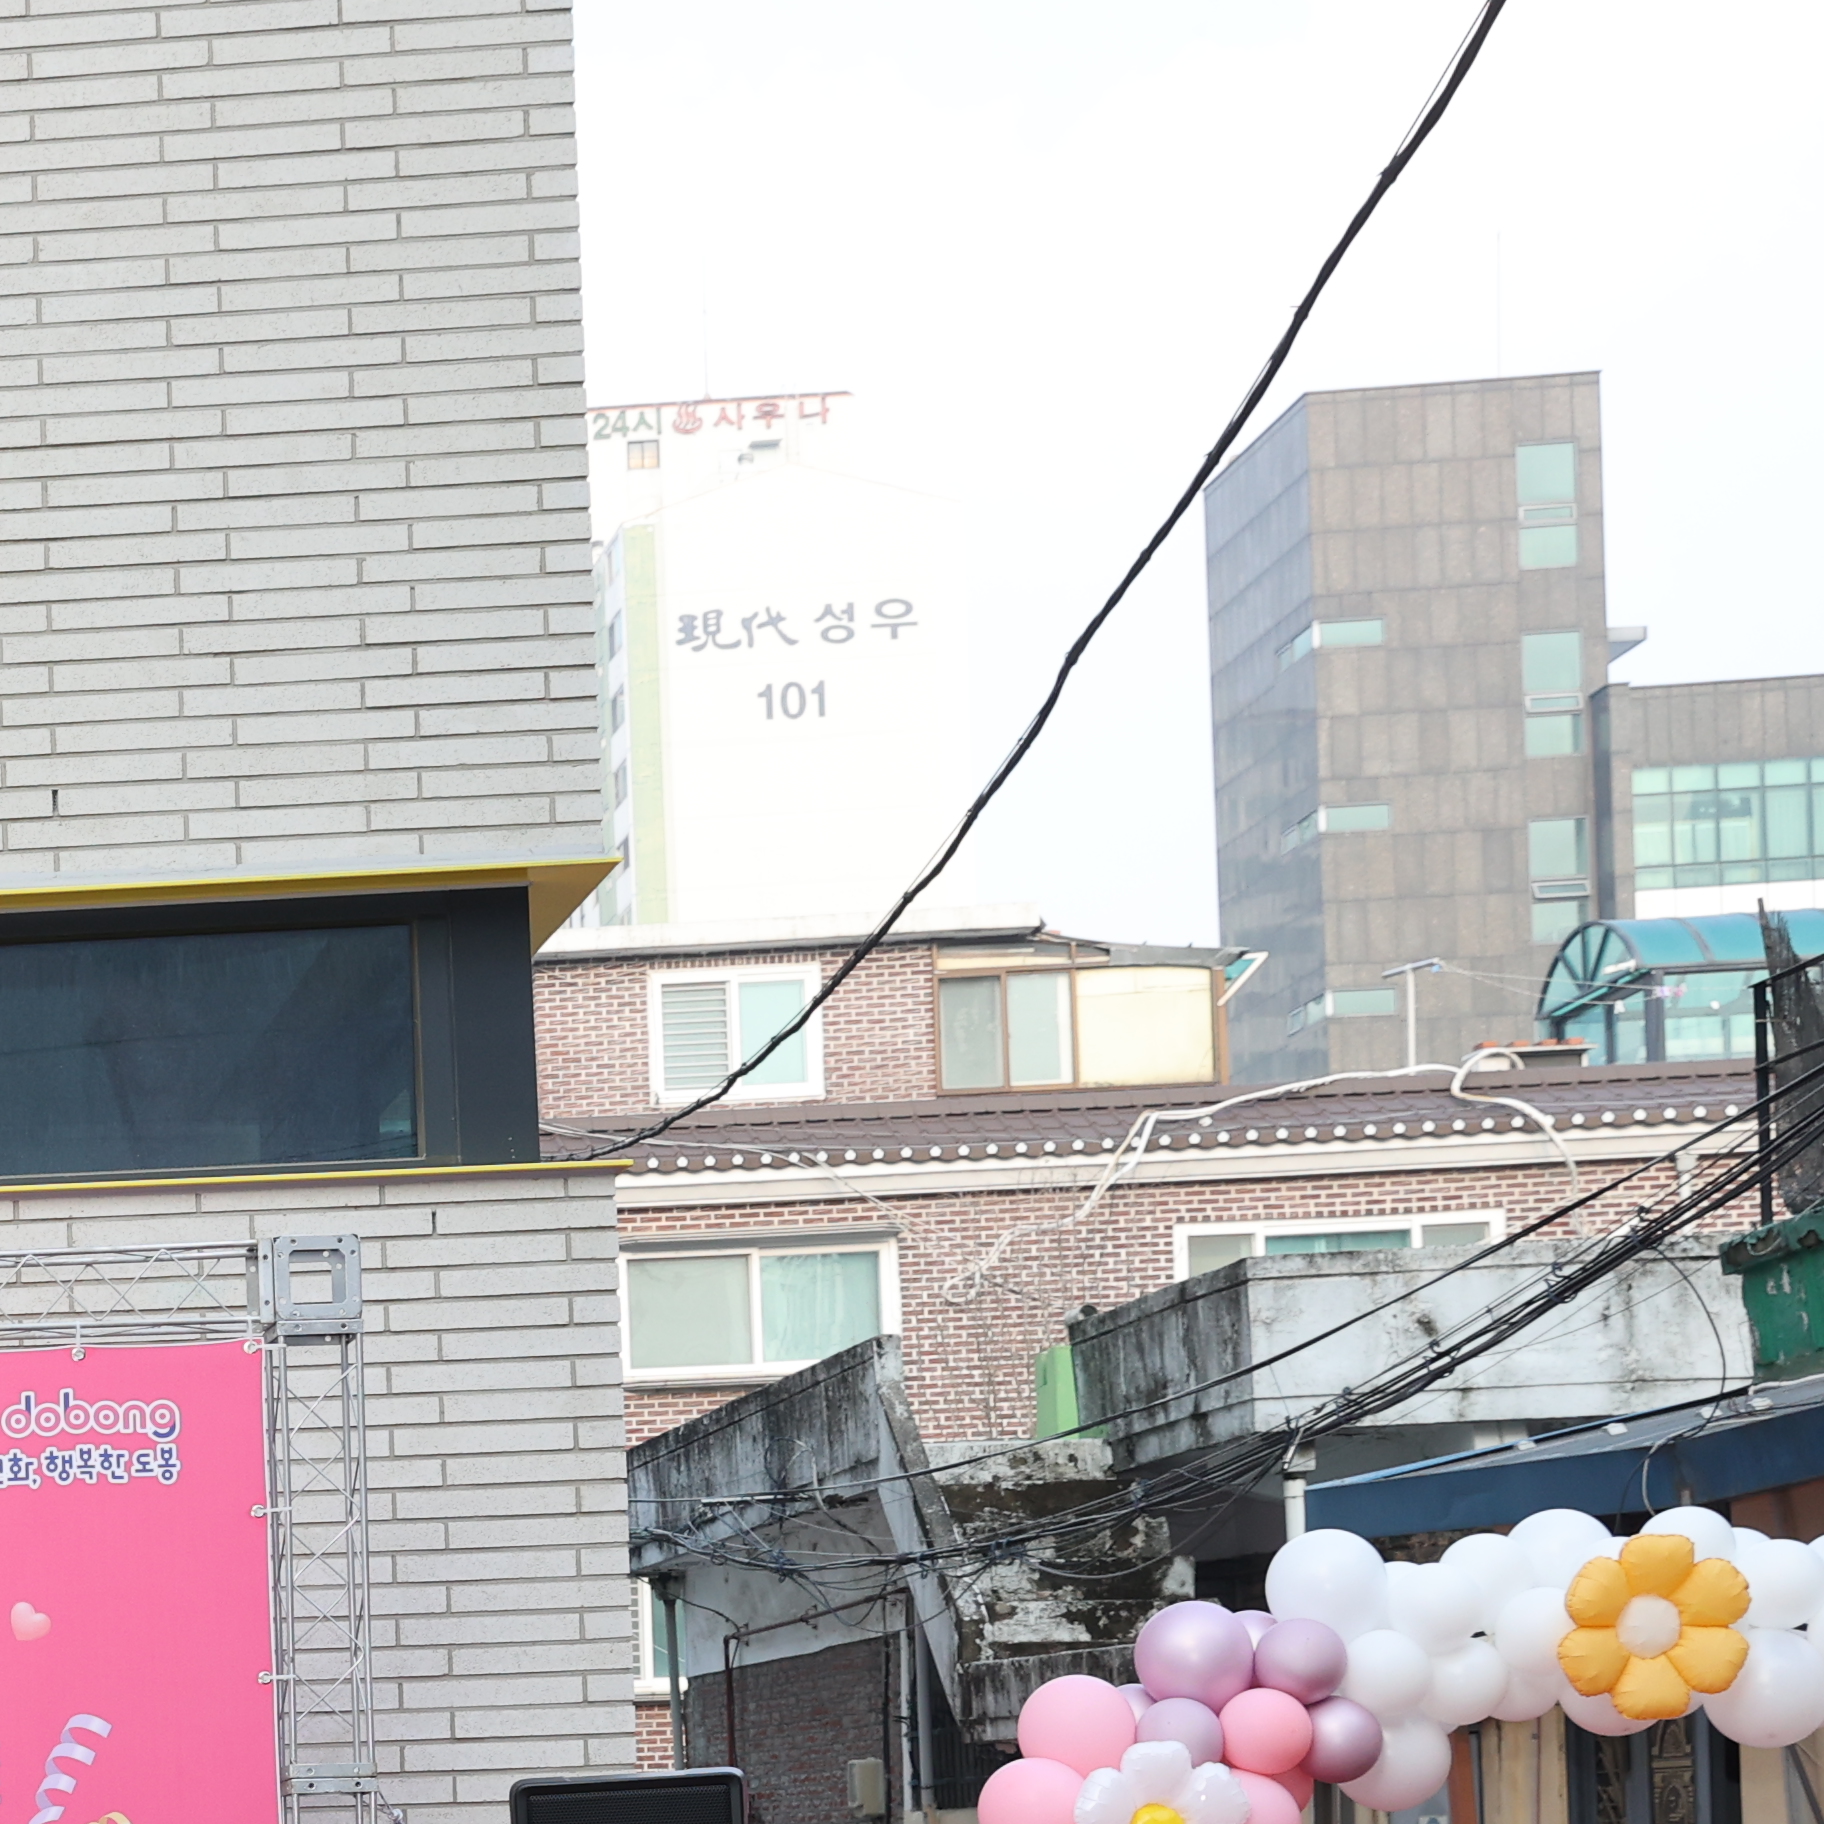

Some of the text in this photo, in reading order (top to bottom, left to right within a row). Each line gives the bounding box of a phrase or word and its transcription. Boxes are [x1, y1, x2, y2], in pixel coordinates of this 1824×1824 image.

[593, 397, 830, 440] 24시 사우나
[757, 680, 826, 720] 101
[2, 1388, 179, 1441] dobong
[42, 1445, 128, 1486] 행복한
[132, 1443, 181, 1486] 도봉
